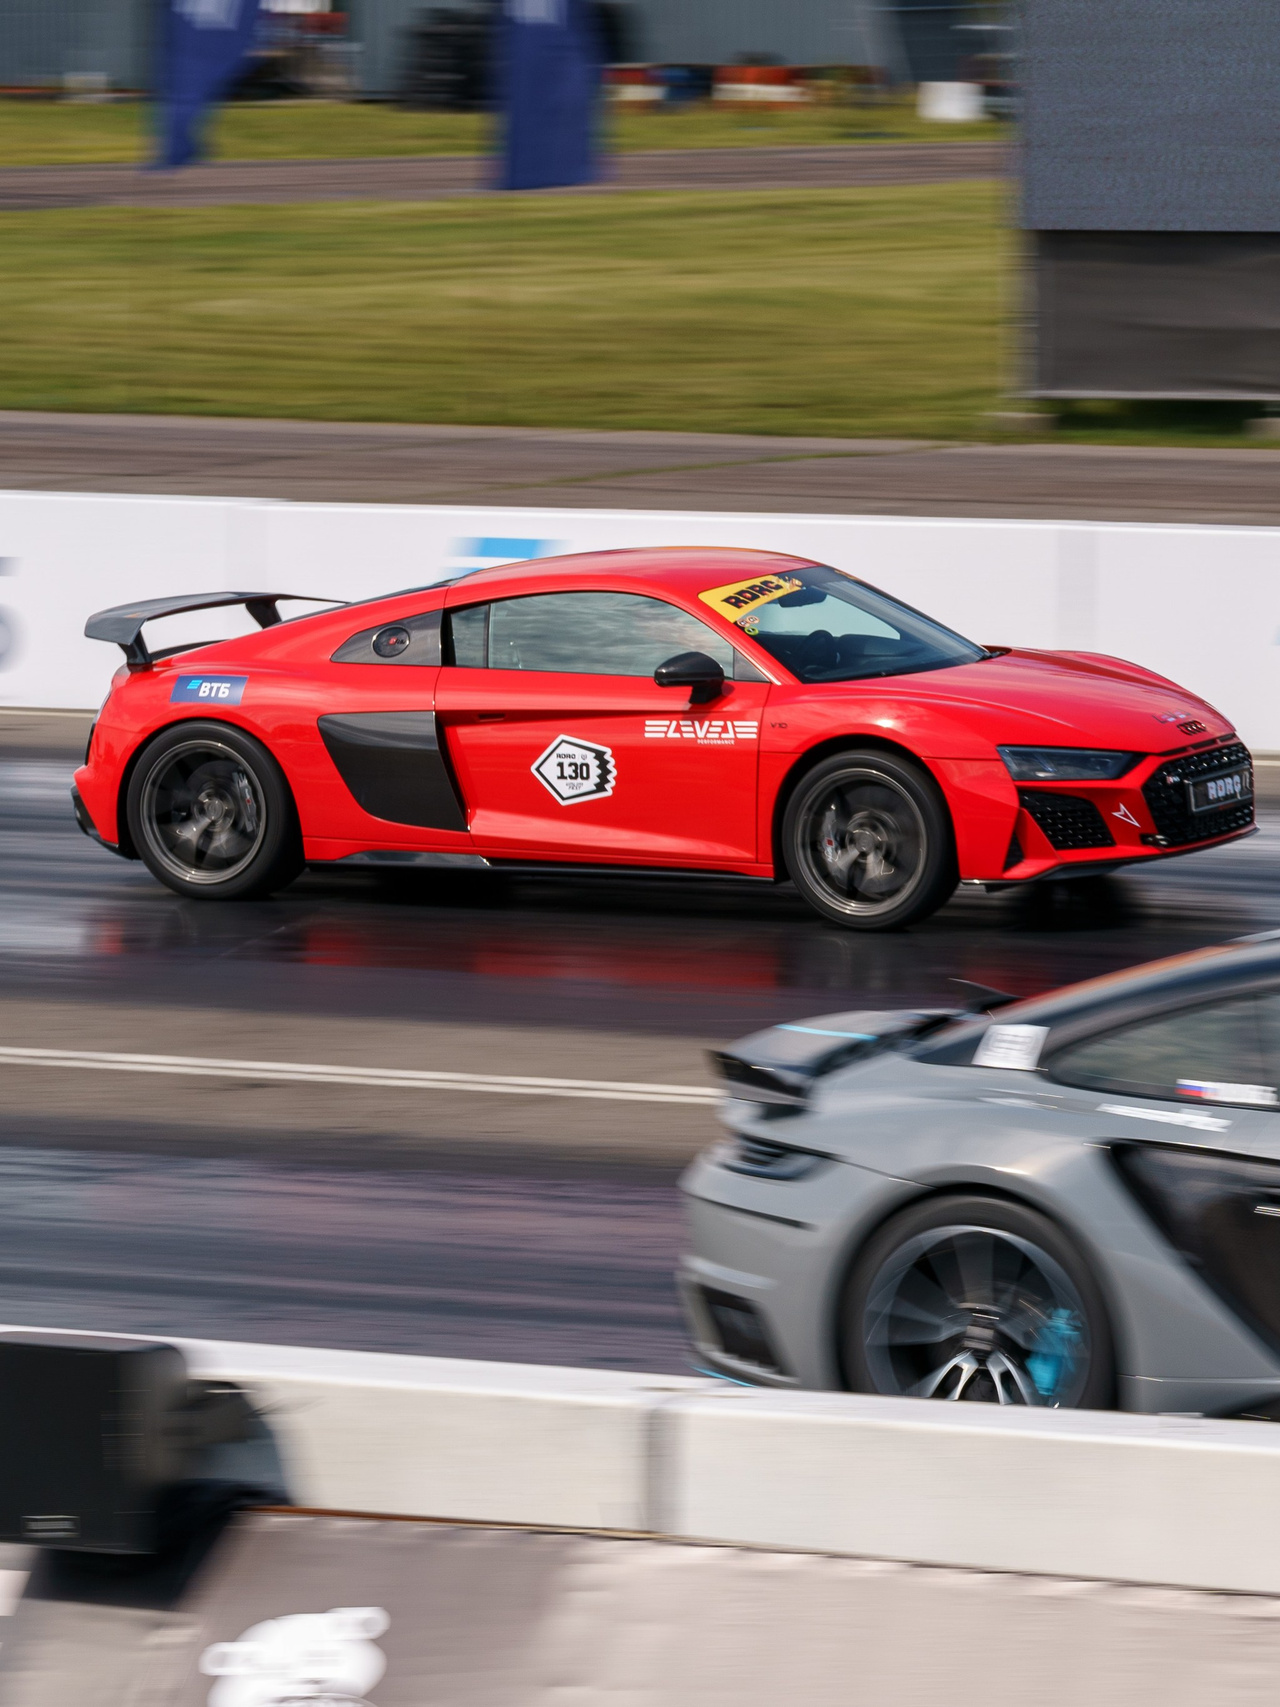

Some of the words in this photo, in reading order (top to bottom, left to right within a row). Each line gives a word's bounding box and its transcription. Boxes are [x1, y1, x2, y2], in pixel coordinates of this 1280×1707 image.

[720, 580, 784, 609] RDRC
[198, 682, 231, 698] ВТБ
[556, 761, 590, 780] 130
